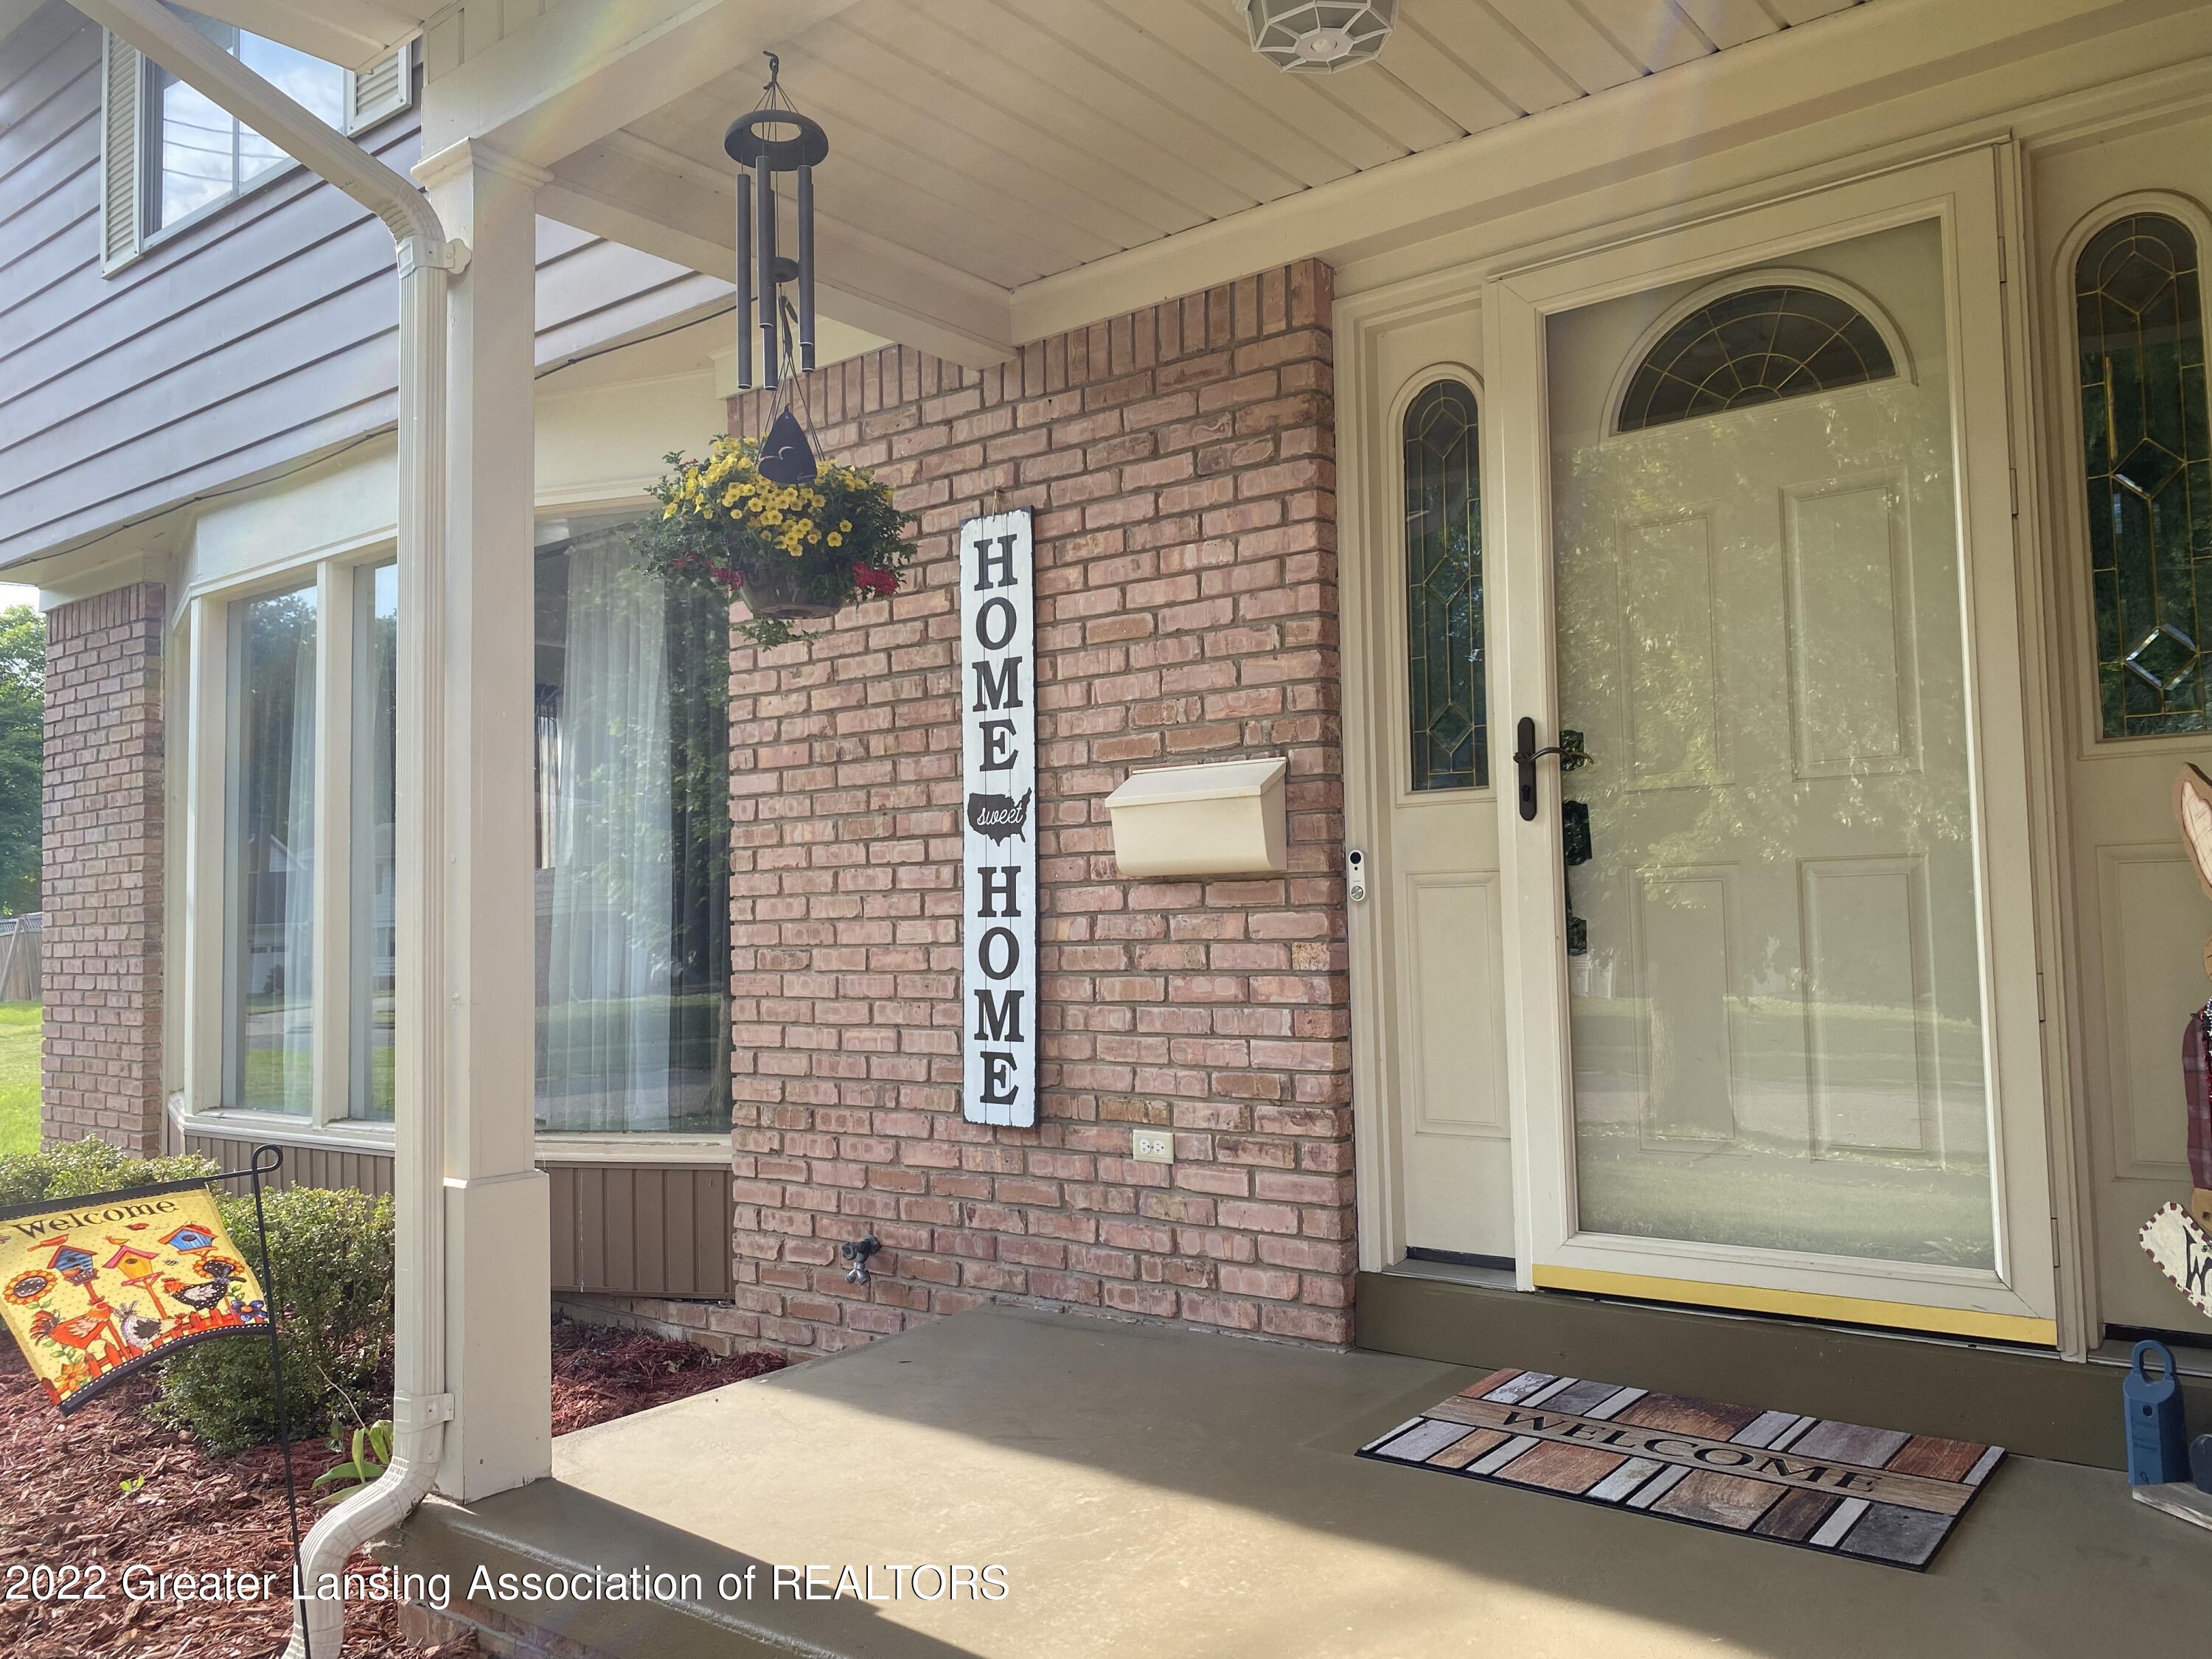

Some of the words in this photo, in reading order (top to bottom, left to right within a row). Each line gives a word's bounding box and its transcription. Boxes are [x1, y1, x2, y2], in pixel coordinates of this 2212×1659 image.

[972, 533, 1023, 772] HOME
[976, 801, 1023, 826] sweet
[973, 865, 1025, 1105] HOME
[1502, 1411, 1883, 1492] WELCOME
